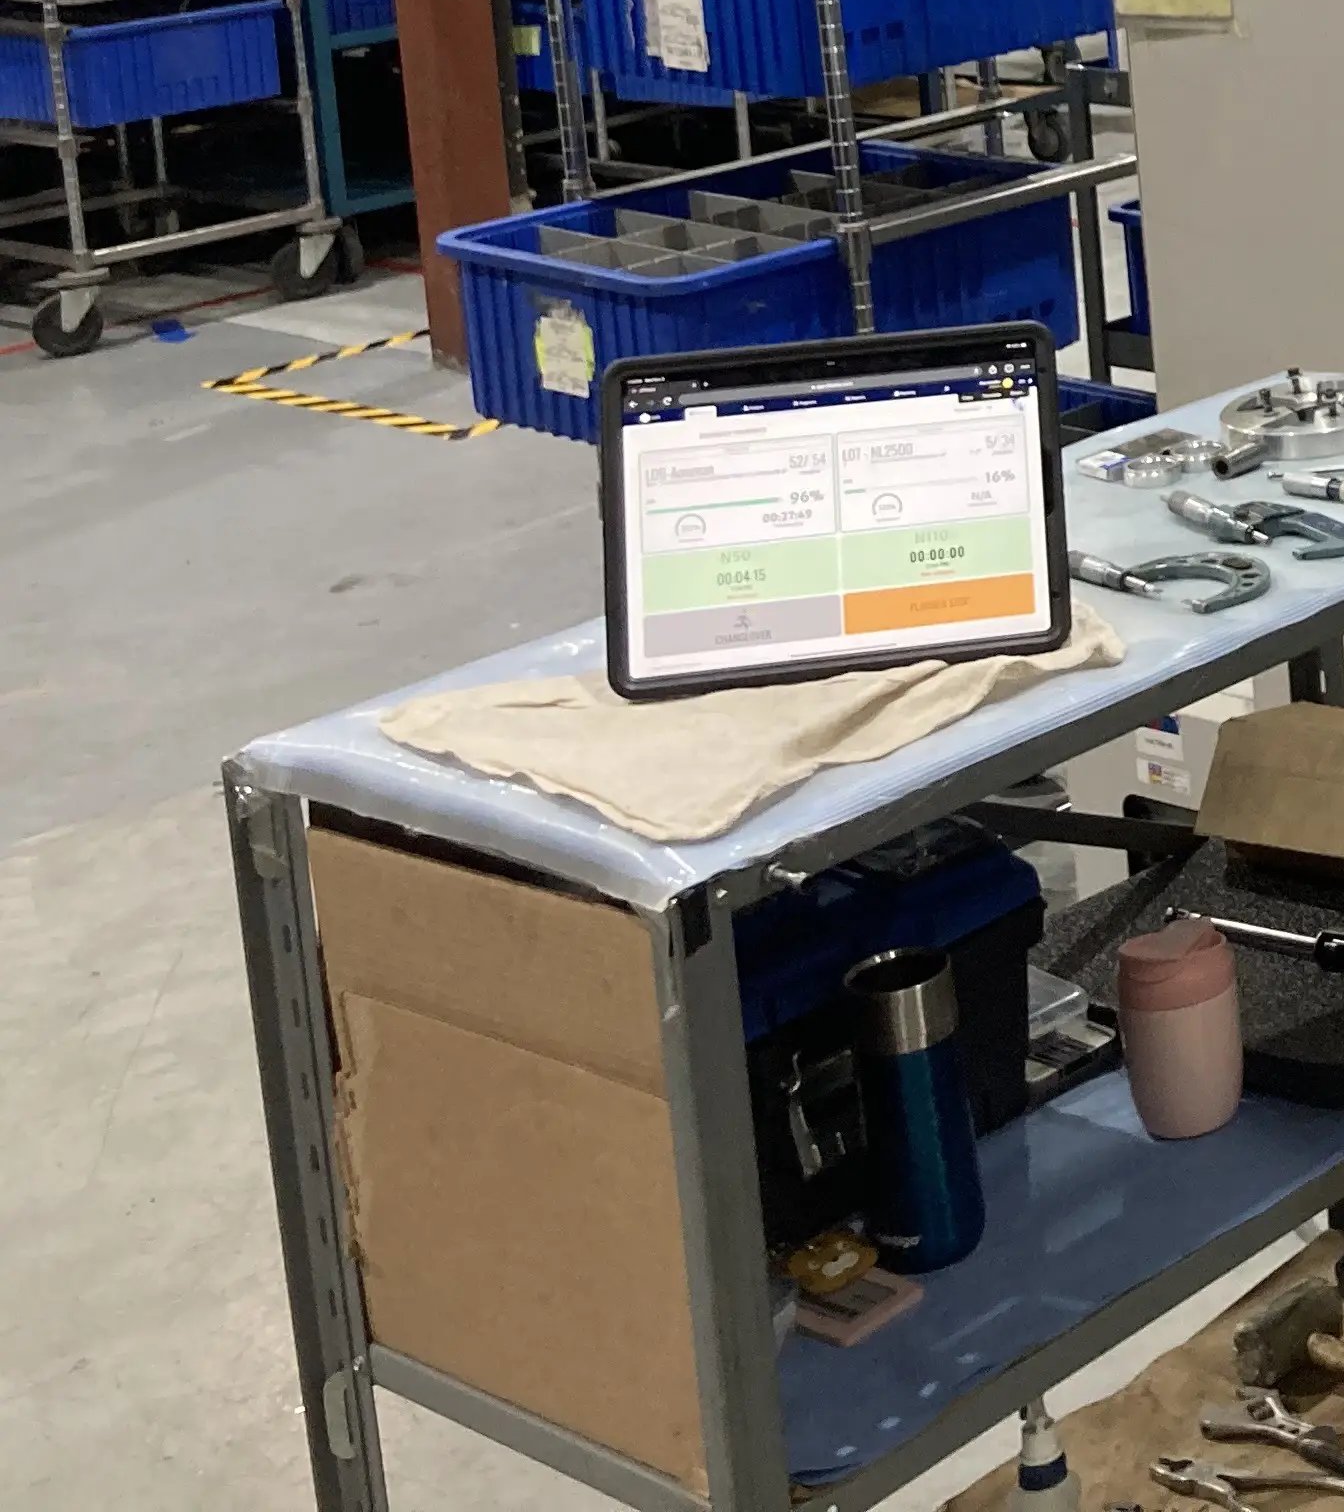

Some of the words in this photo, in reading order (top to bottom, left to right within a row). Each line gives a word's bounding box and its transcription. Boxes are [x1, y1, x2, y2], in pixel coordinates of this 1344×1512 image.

[985, 469, 1016, 484] 16%
[790, 489, 824, 504] 96%
[910, 545, 965, 563] 00:00:00
